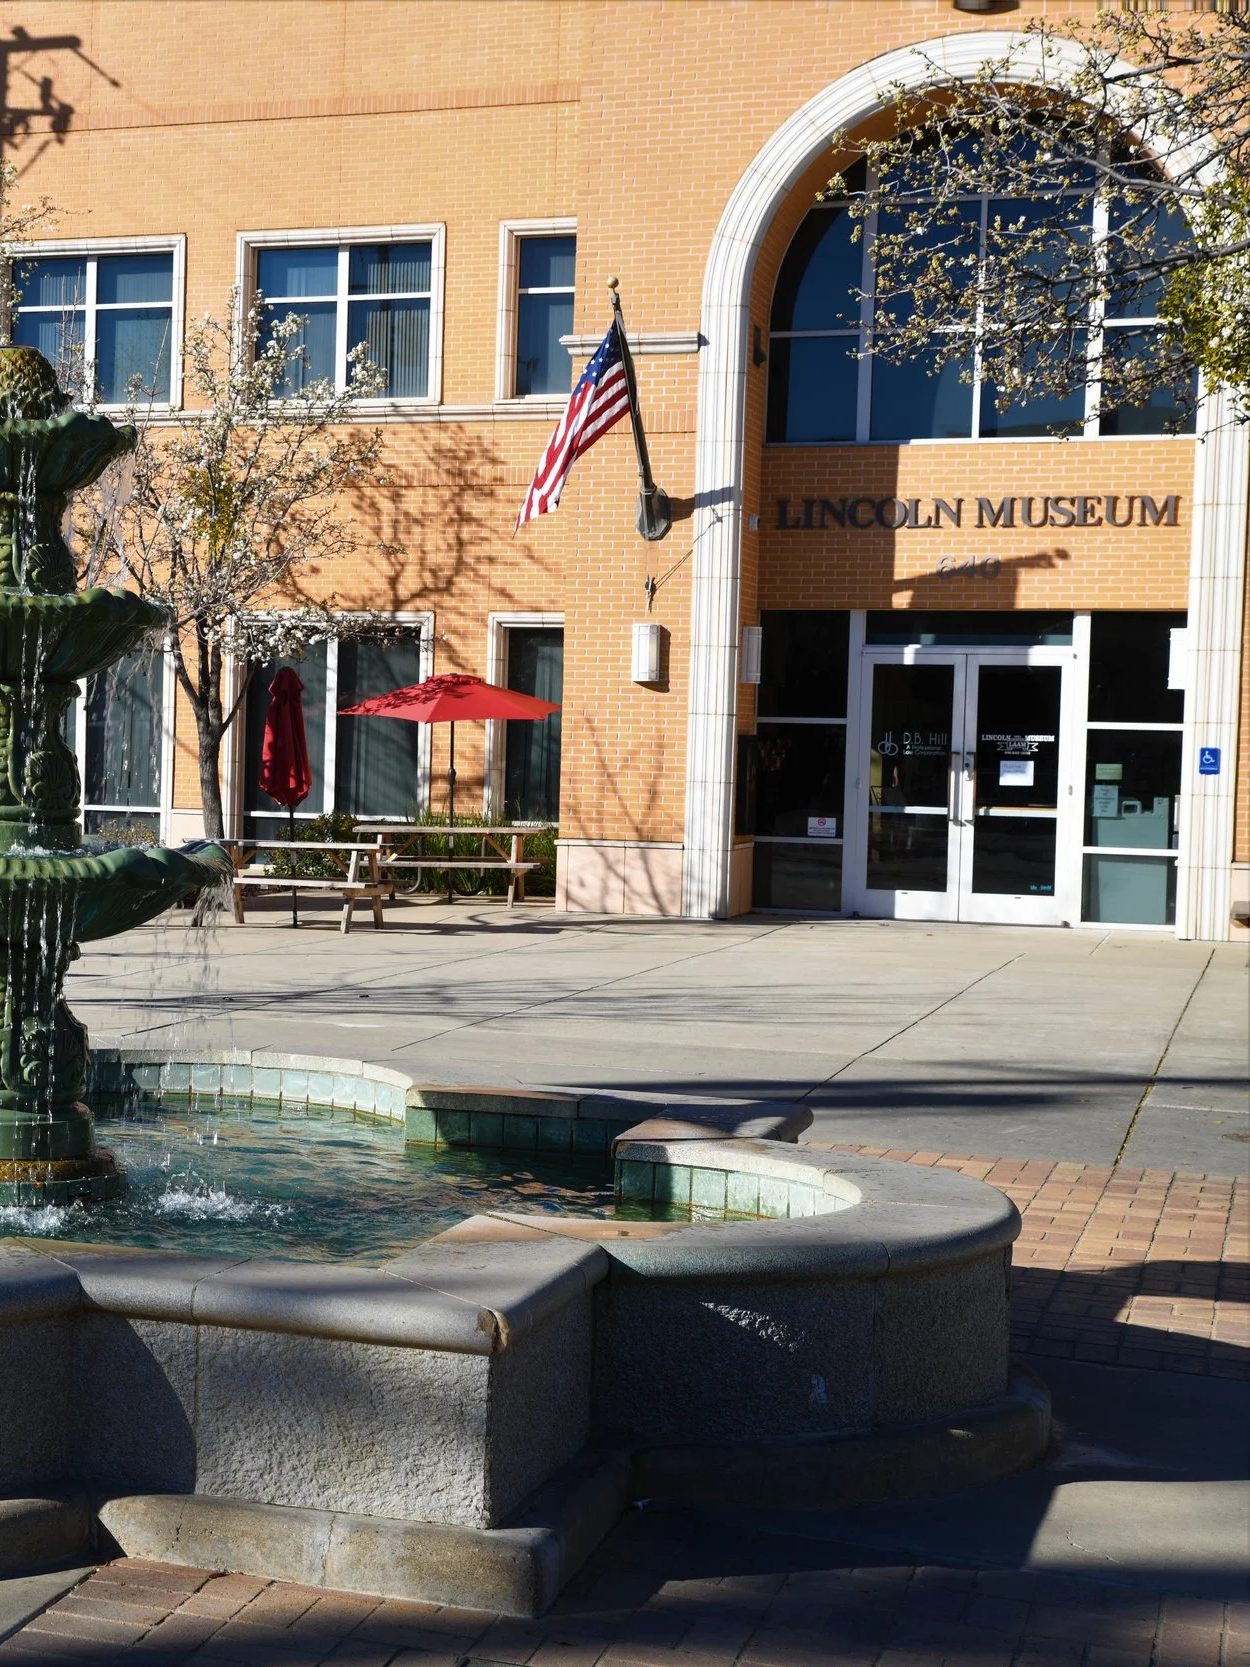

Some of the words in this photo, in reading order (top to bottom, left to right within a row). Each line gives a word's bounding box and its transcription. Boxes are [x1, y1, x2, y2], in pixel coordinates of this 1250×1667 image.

[775, 496, 965, 529] LINCOLN
[975, 494, 1182, 528] MUSEUM
[936, 554, 1002, 580] 640
[903, 732, 924, 744] D.B.
[930, 732, 947, 744] Hill
